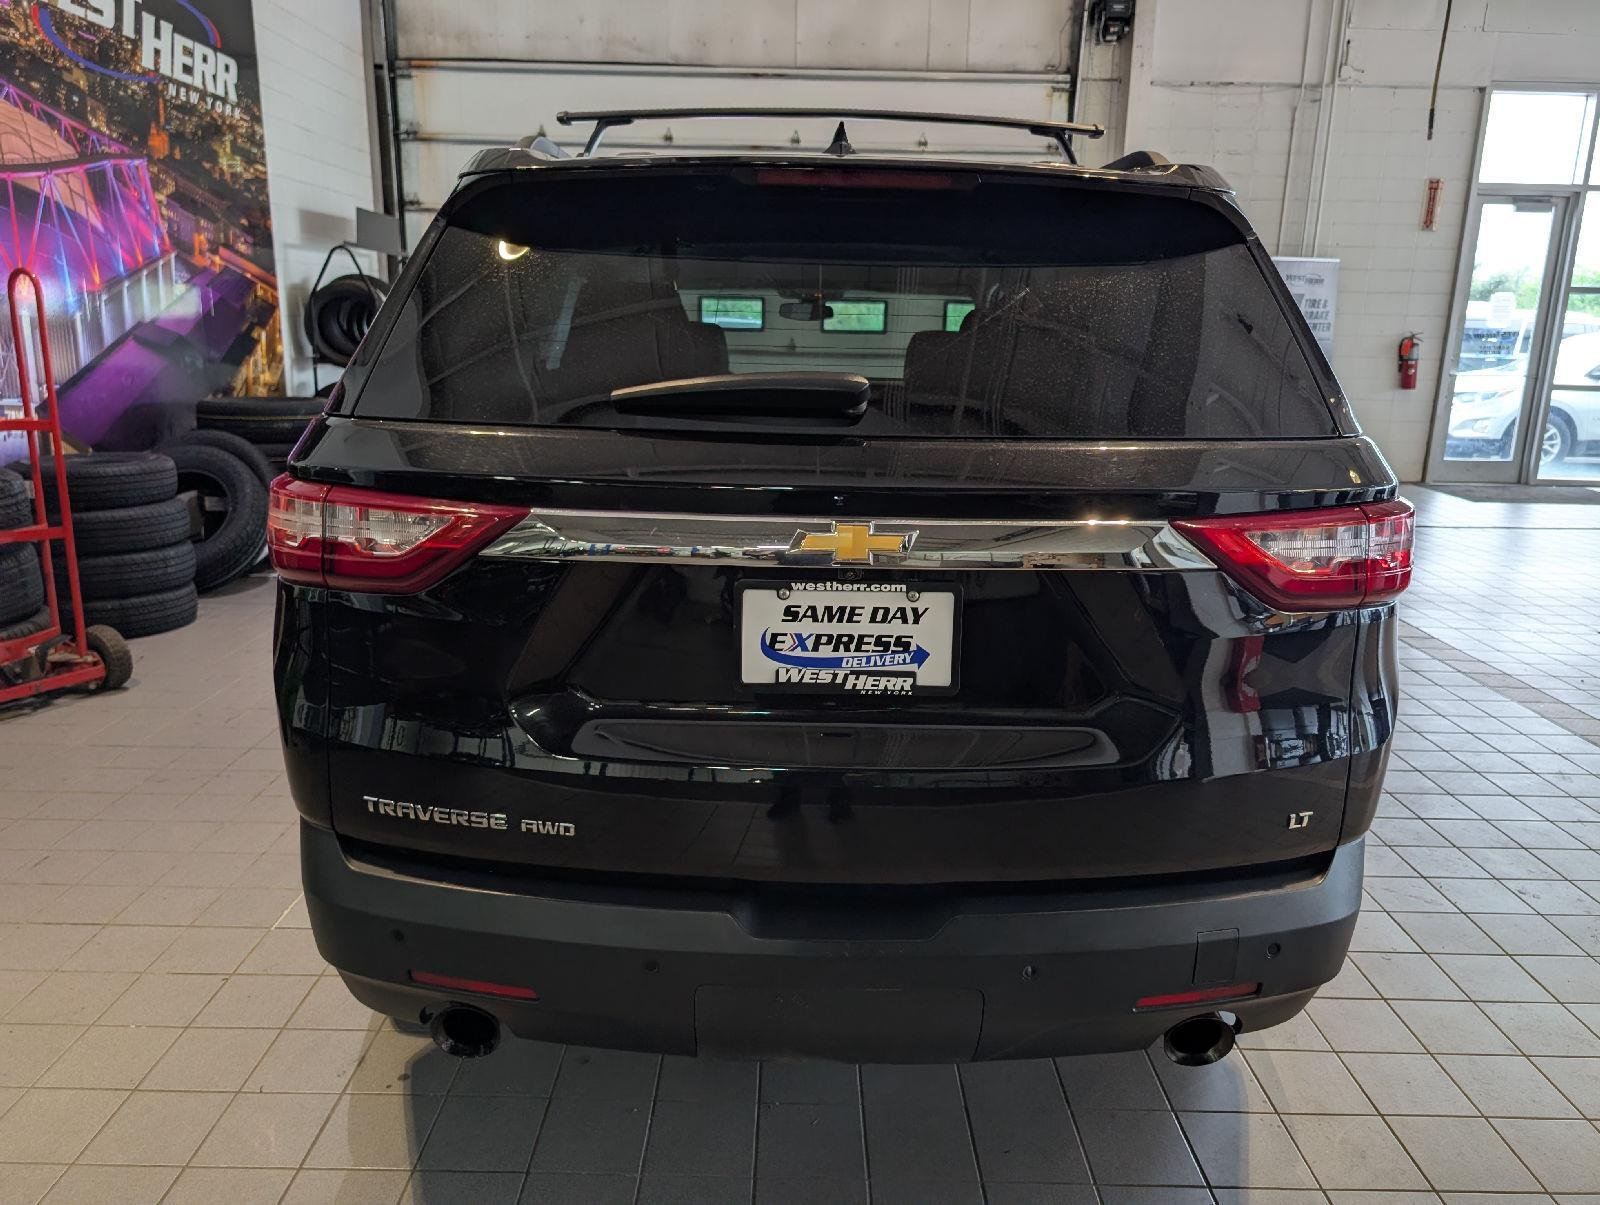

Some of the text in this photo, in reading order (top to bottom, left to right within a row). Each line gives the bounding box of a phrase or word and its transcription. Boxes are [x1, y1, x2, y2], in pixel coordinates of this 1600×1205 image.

[167, 82, 241, 119] NEW YORK
[790, 581, 907, 592] westherr.com
[781, 604, 930, 625] SAME DAY
[769, 632, 914, 653] EXPRESS
[841, 651, 915, 668] DELIVERY
[363, 795, 577, 837] TRAVERSE AWD
[1288, 811, 1314, 830] LT
